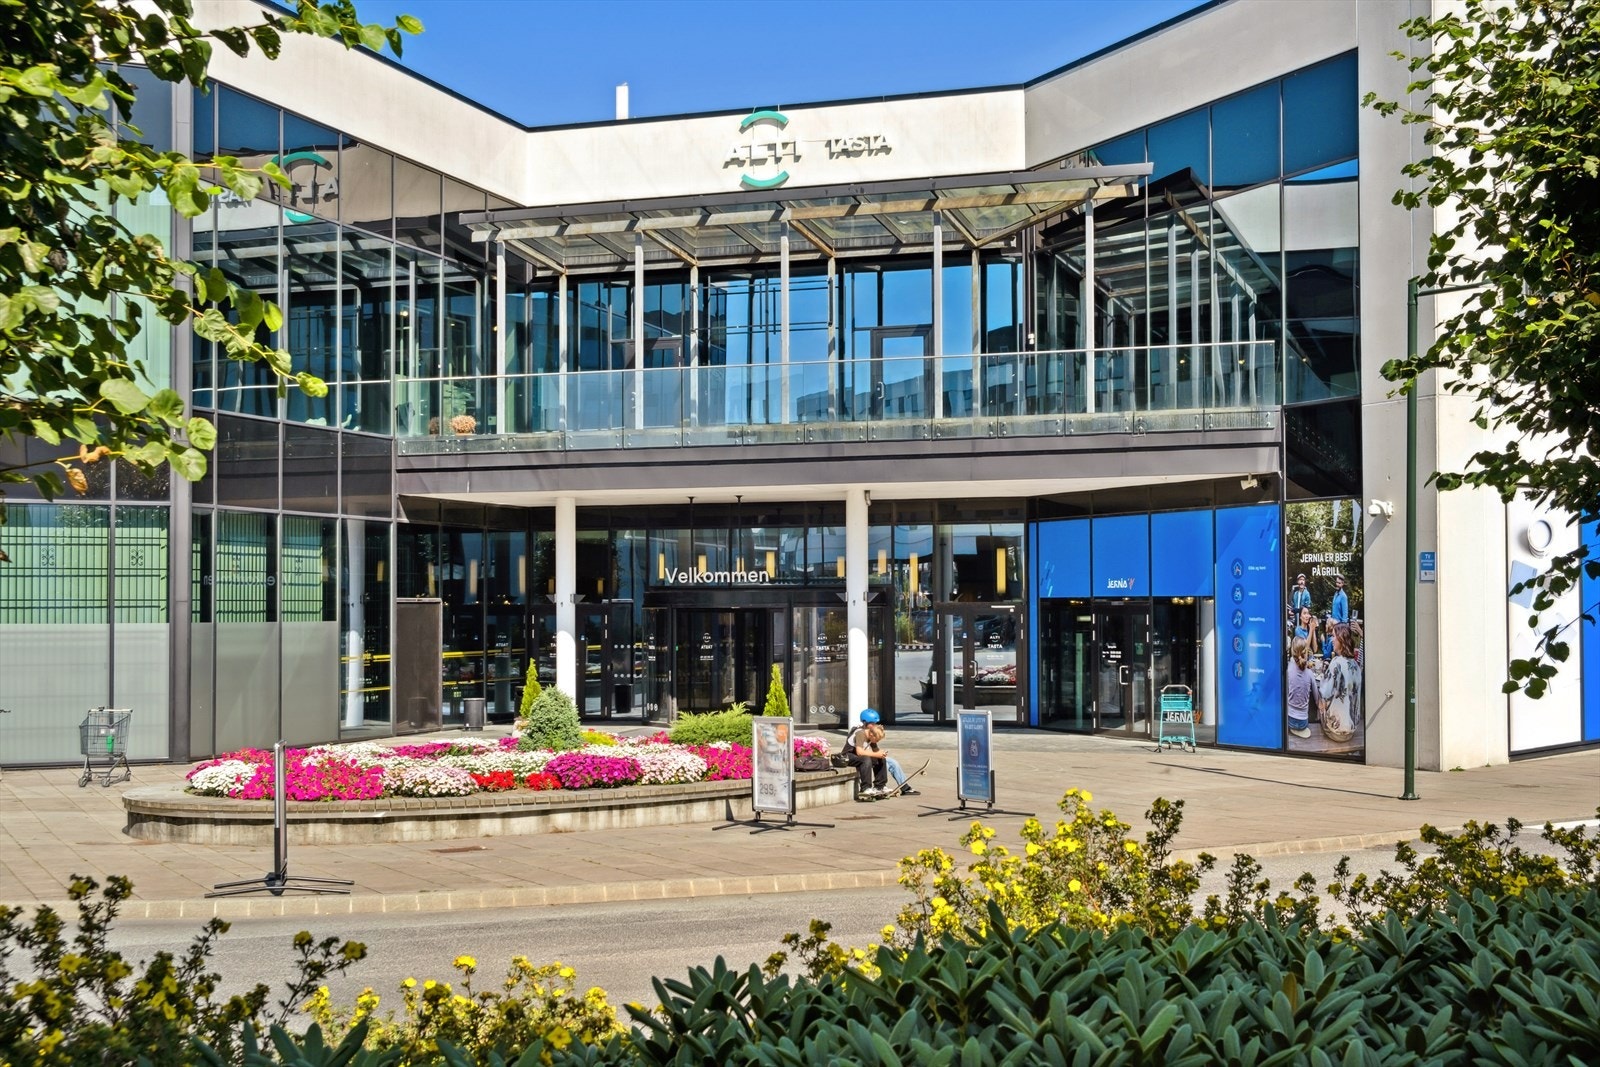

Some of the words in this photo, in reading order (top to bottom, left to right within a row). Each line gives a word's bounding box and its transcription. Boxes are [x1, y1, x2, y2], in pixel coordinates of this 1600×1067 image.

[1300, 553, 1324, 563] JERNIA
[1324, 553, 1334, 562] ER
[1335, 552, 1353, 562] BEST
[664, 566, 770, 585] Velkommen
[1312, 564, 1321, 576] PÅ
[1321, 566, 1340, 576] GRILL
